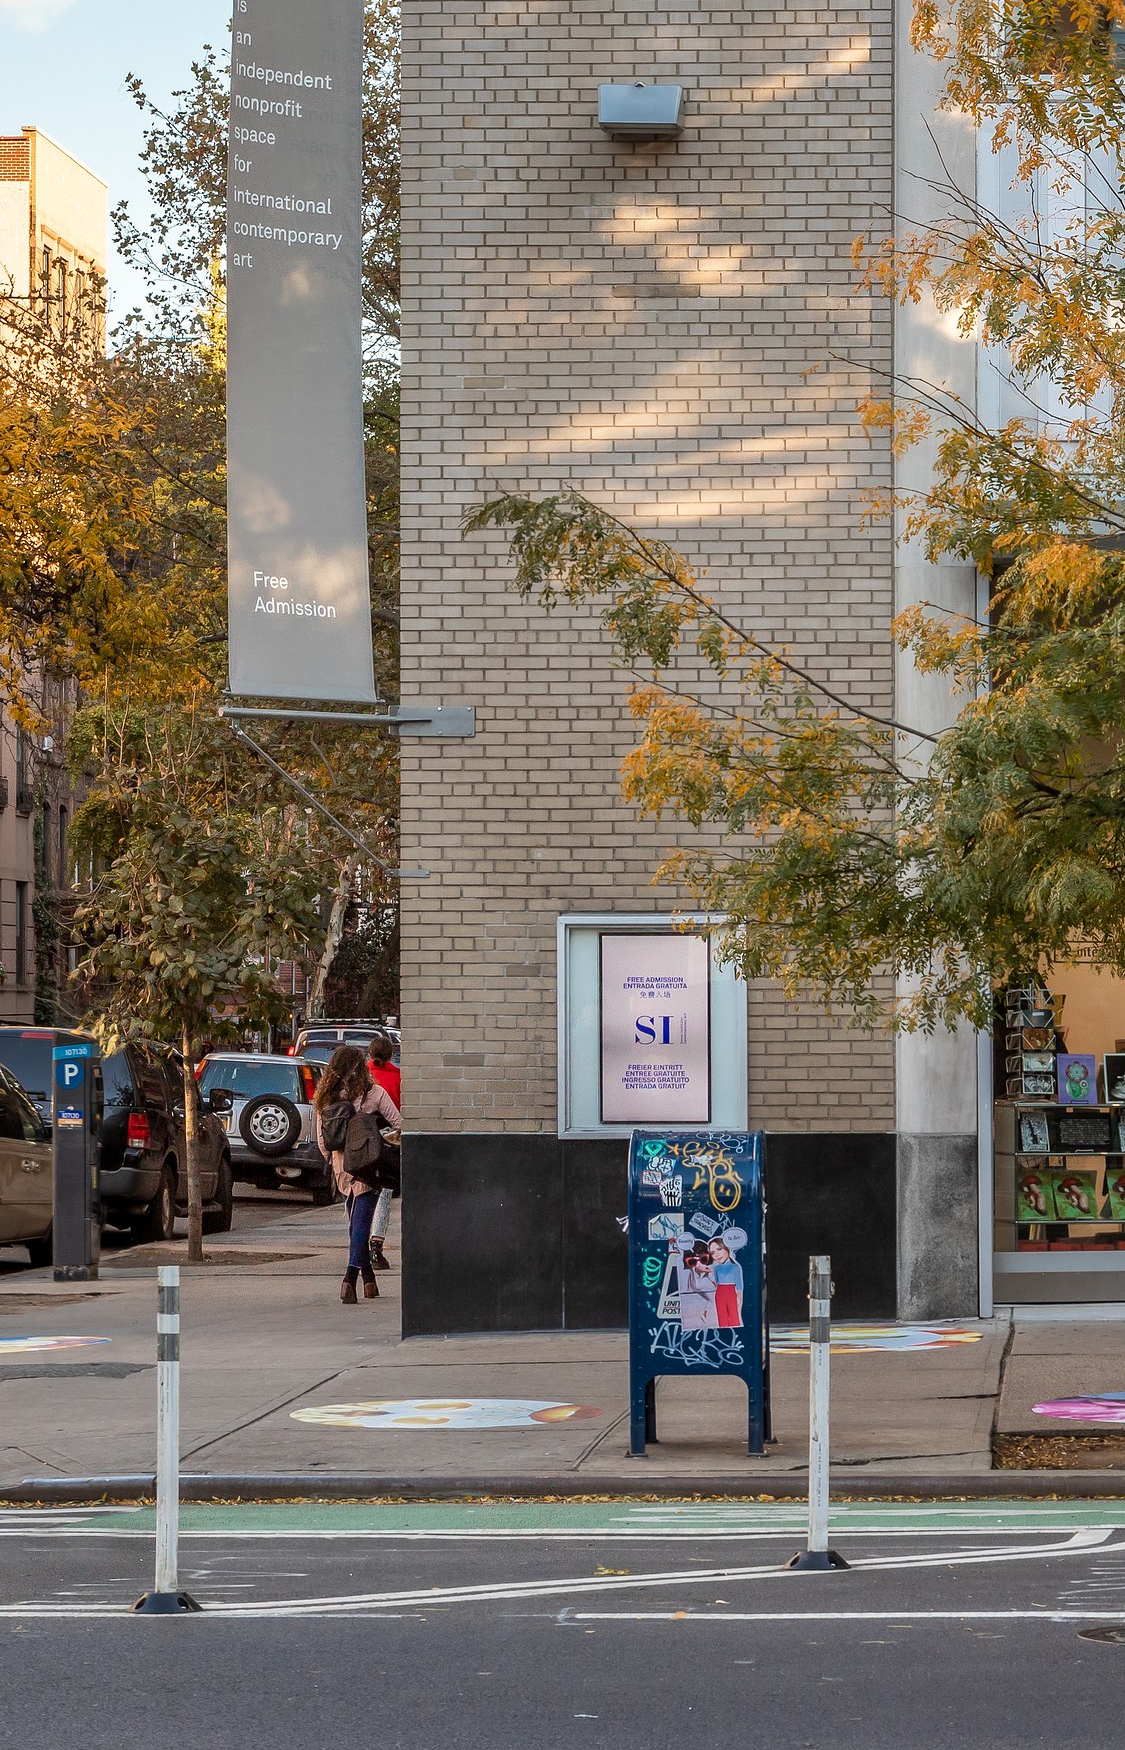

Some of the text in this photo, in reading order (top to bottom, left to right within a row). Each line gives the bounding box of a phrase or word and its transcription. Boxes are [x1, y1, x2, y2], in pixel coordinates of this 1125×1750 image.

[236, 31, 252, 45] an
[236, 58, 333, 90] independent
[235, 94, 302, 118] nonprofit
[234, 126, 276, 145] space
[233, 154, 252, 172] for
[234, 186, 332, 215] international
[233, 221, 343, 250] contemporary
[233, 253, 253, 268] art
[253, 571, 288, 589] Free
[254, 596, 337, 618] Admission
[635, 1015, 674, 1045] SI
[65, 1048, 88, 1056] 107130
[64, 1063, 79, 1085] P
